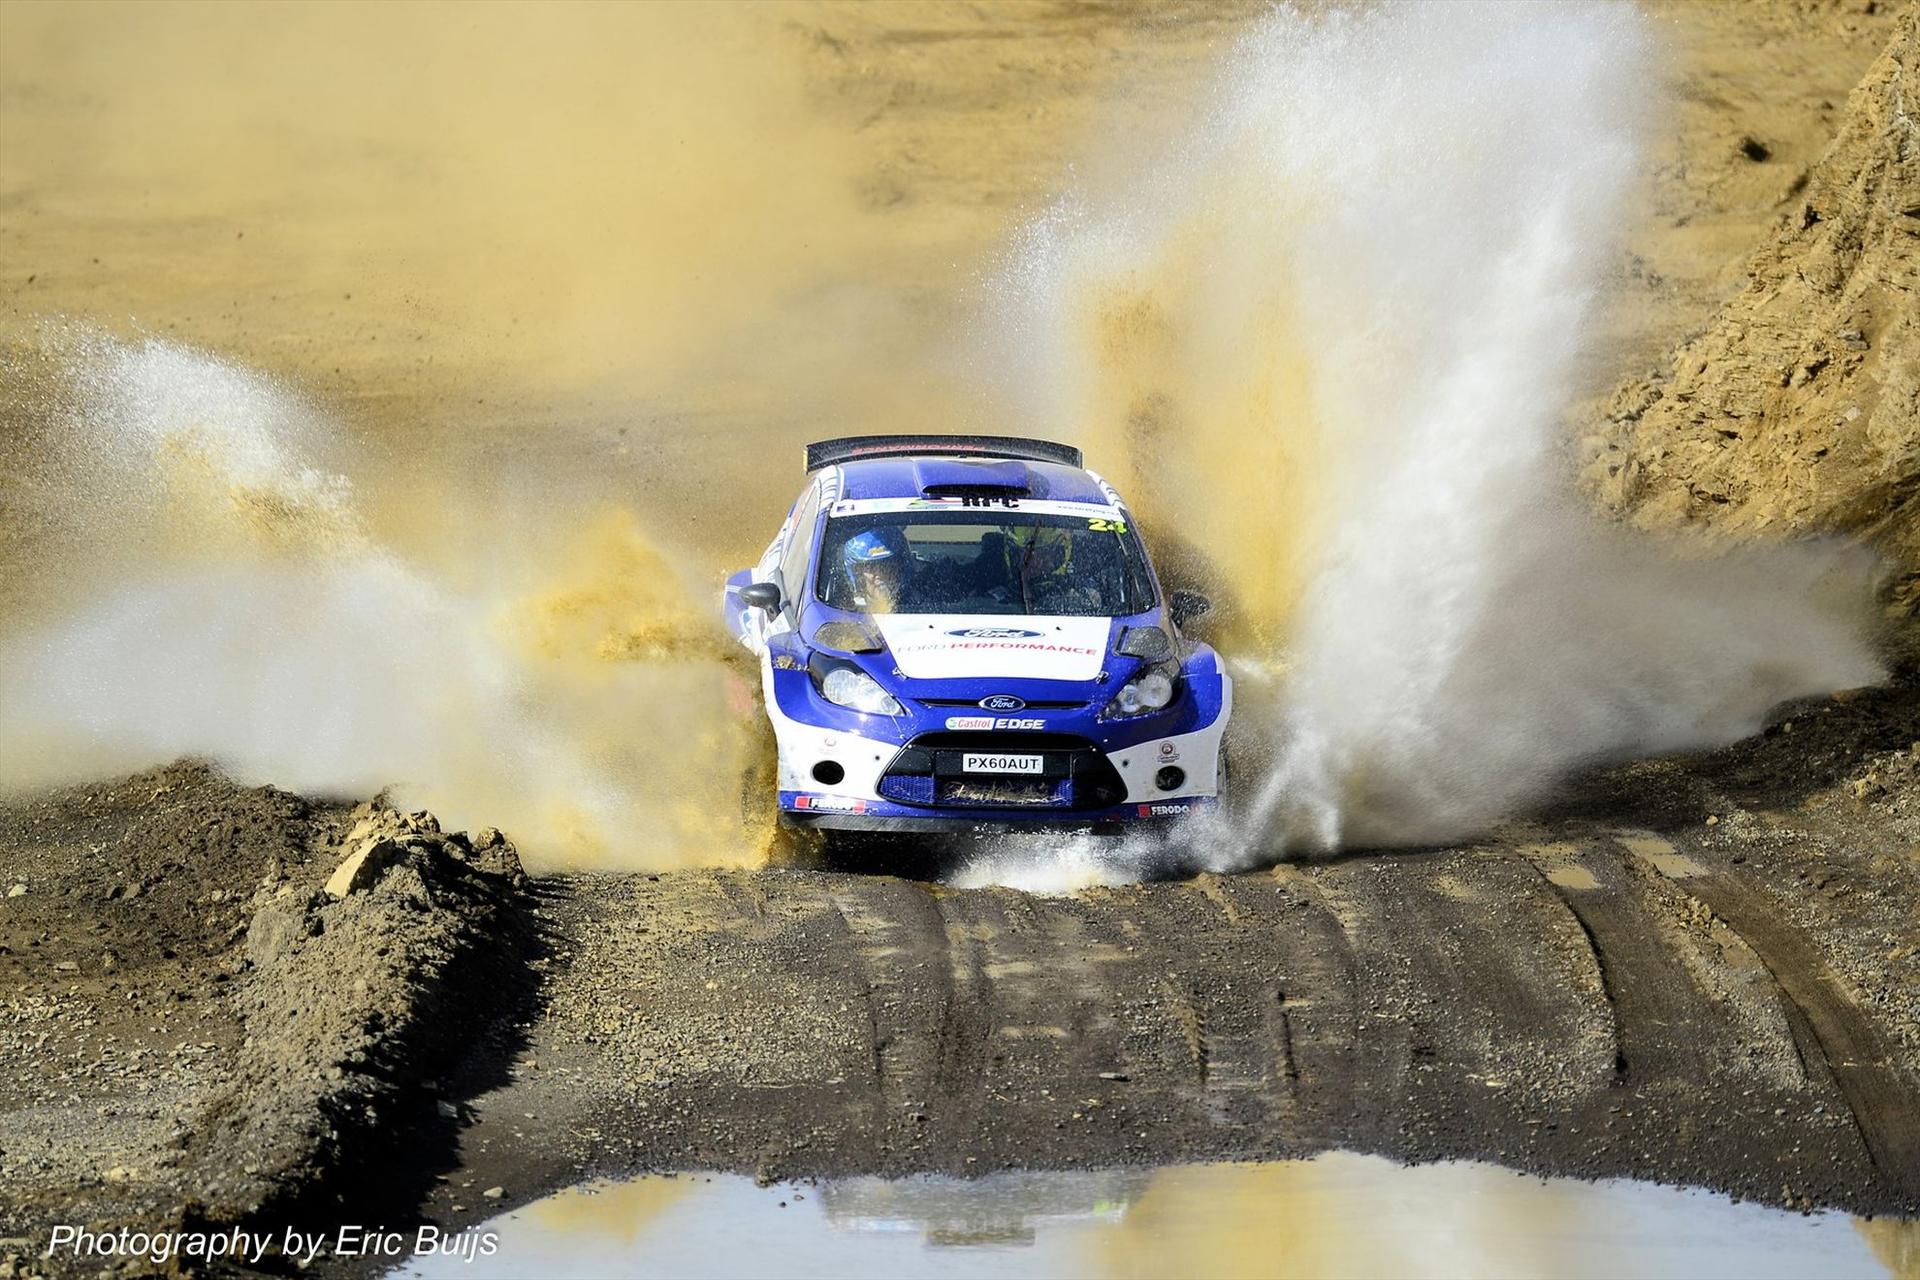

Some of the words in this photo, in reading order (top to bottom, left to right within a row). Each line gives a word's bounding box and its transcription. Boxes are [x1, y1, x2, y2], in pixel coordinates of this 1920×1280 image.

[963, 627, 1025, 638] Ford
[950, 642, 1098, 656] PERFORMANCE
[990, 698, 1015, 708] Ford
[957, 719, 991, 729] Castrol
[995, 718, 1047, 730] EDGE
[967, 757, 1039, 770] PX60AUT
[1150, 805, 1191, 816] FERODO
